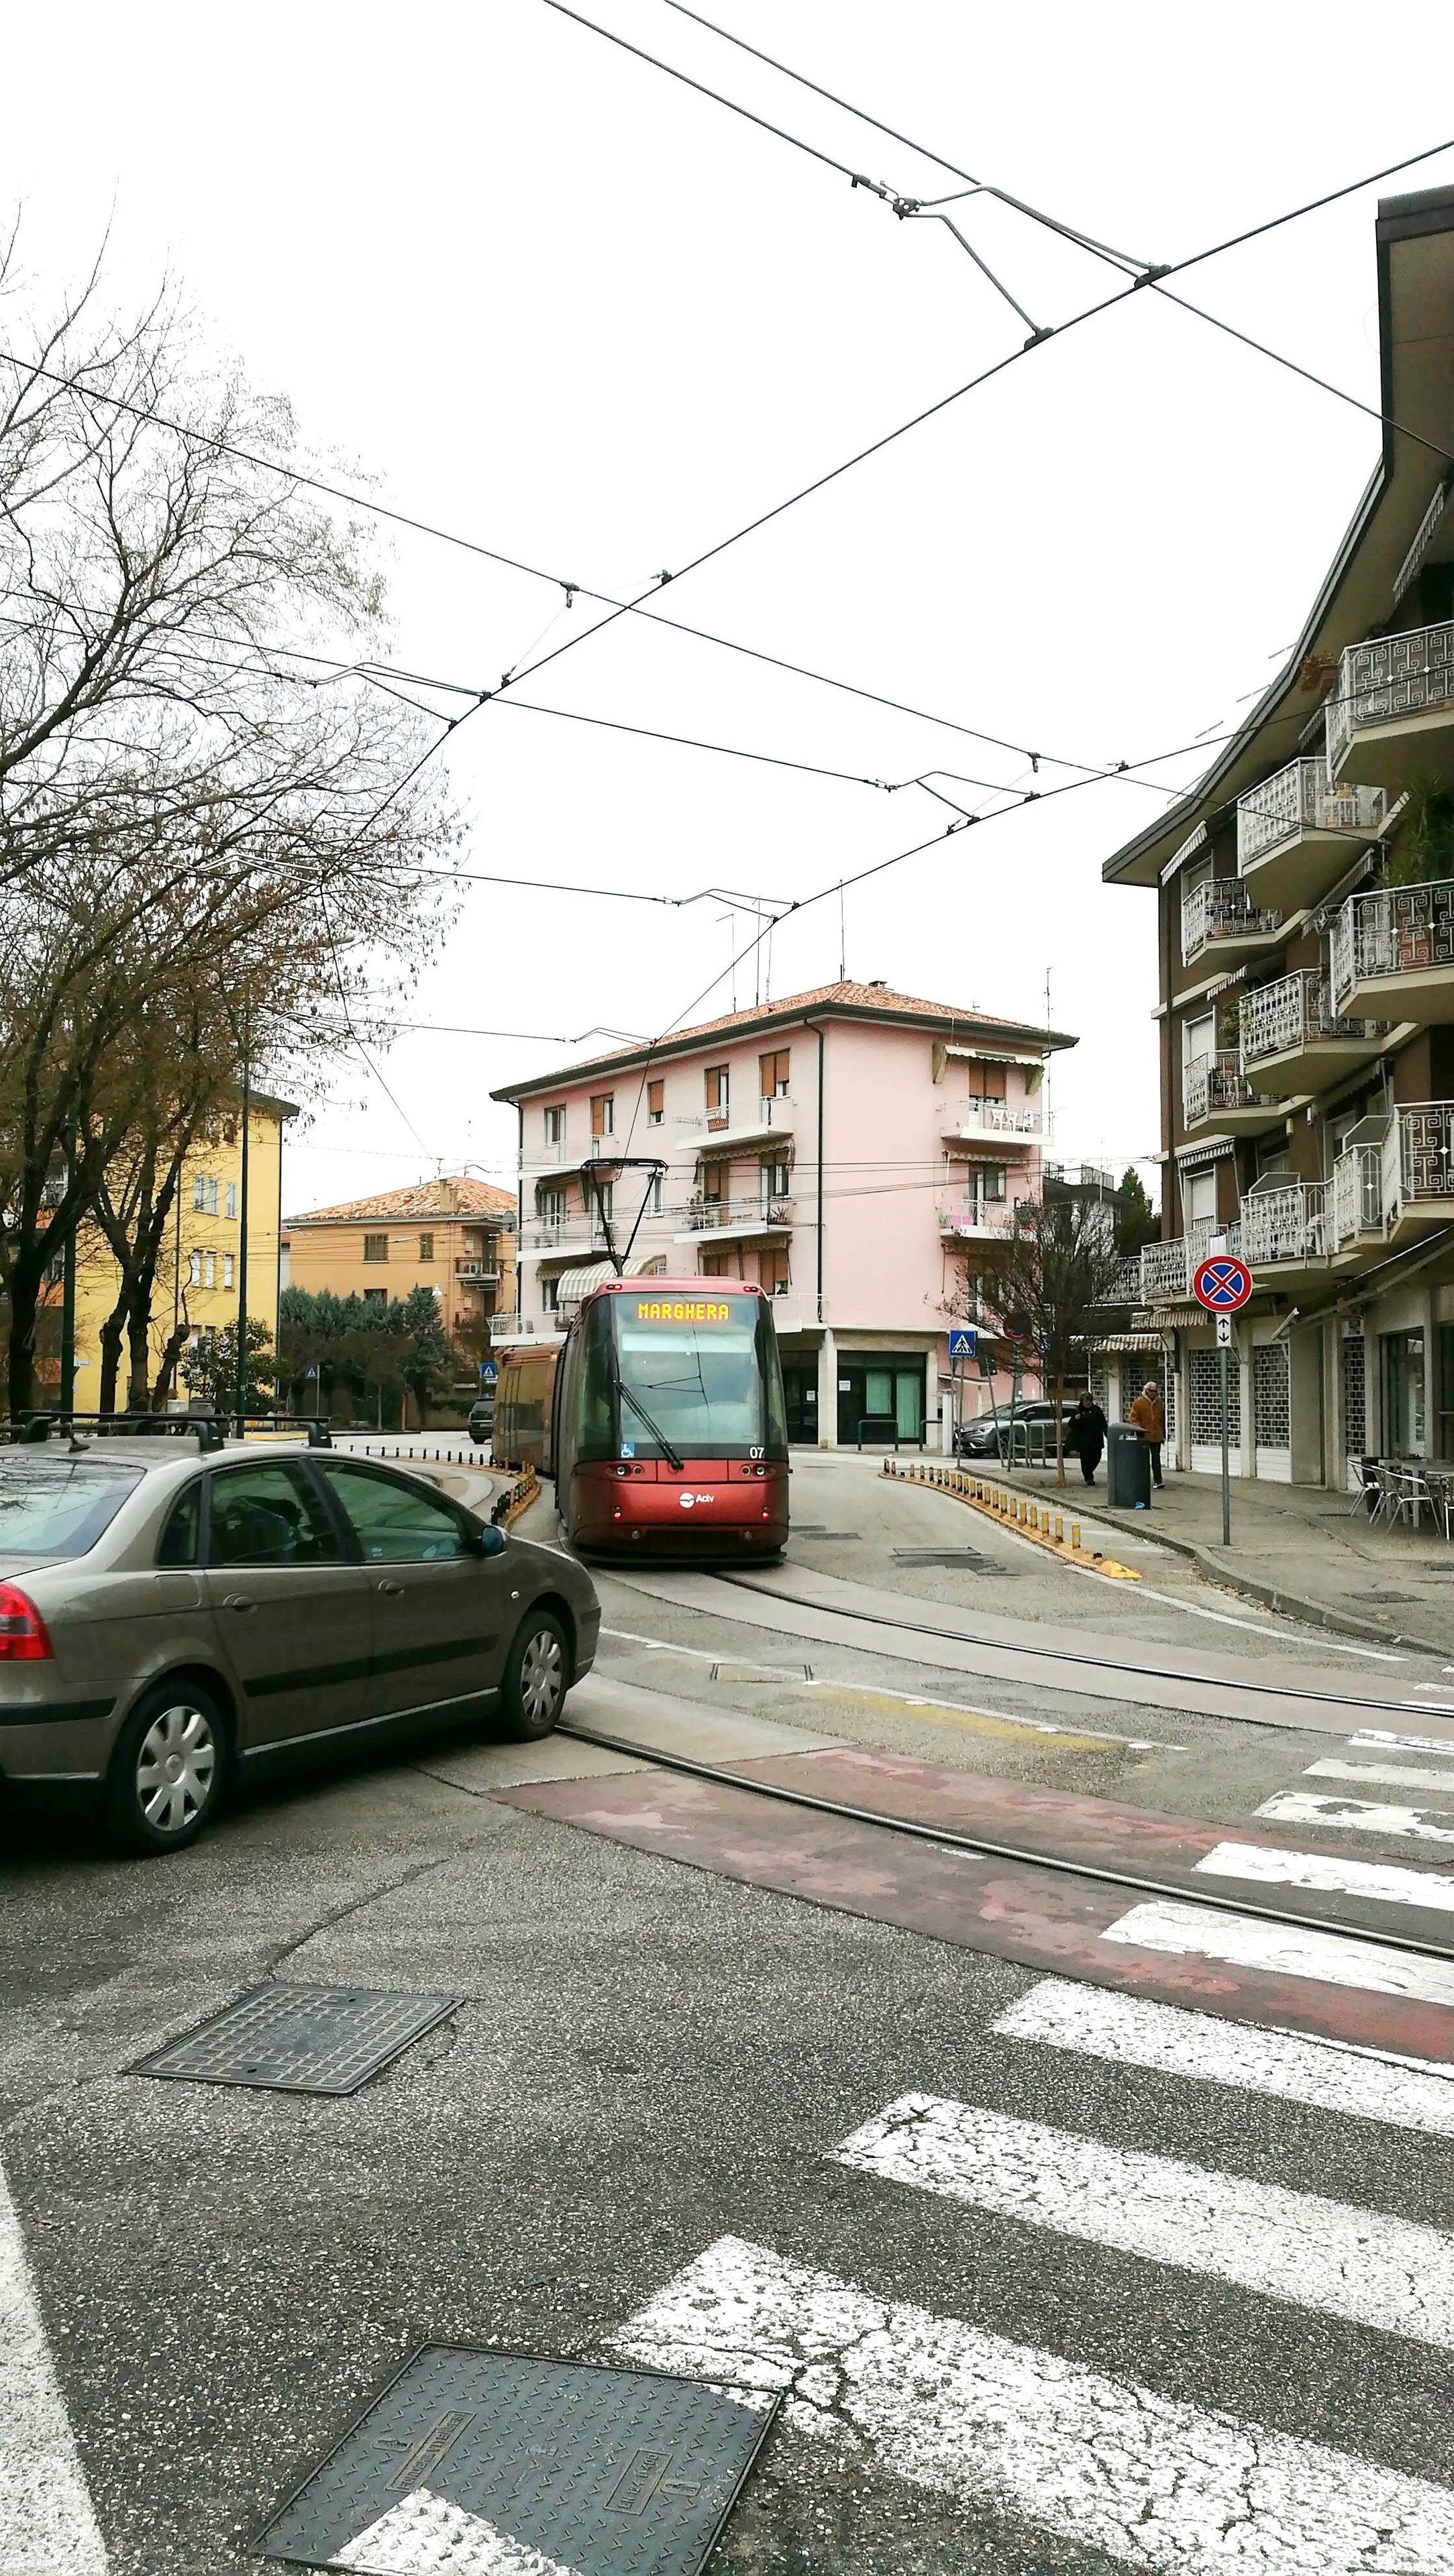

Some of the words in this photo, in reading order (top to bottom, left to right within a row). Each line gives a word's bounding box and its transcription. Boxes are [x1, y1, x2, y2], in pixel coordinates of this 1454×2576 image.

[637, 1302, 729, 1320] MARGHERA
[749, 1446, 765, 1459] 07
[617, 2496, 635, 2510] EN
